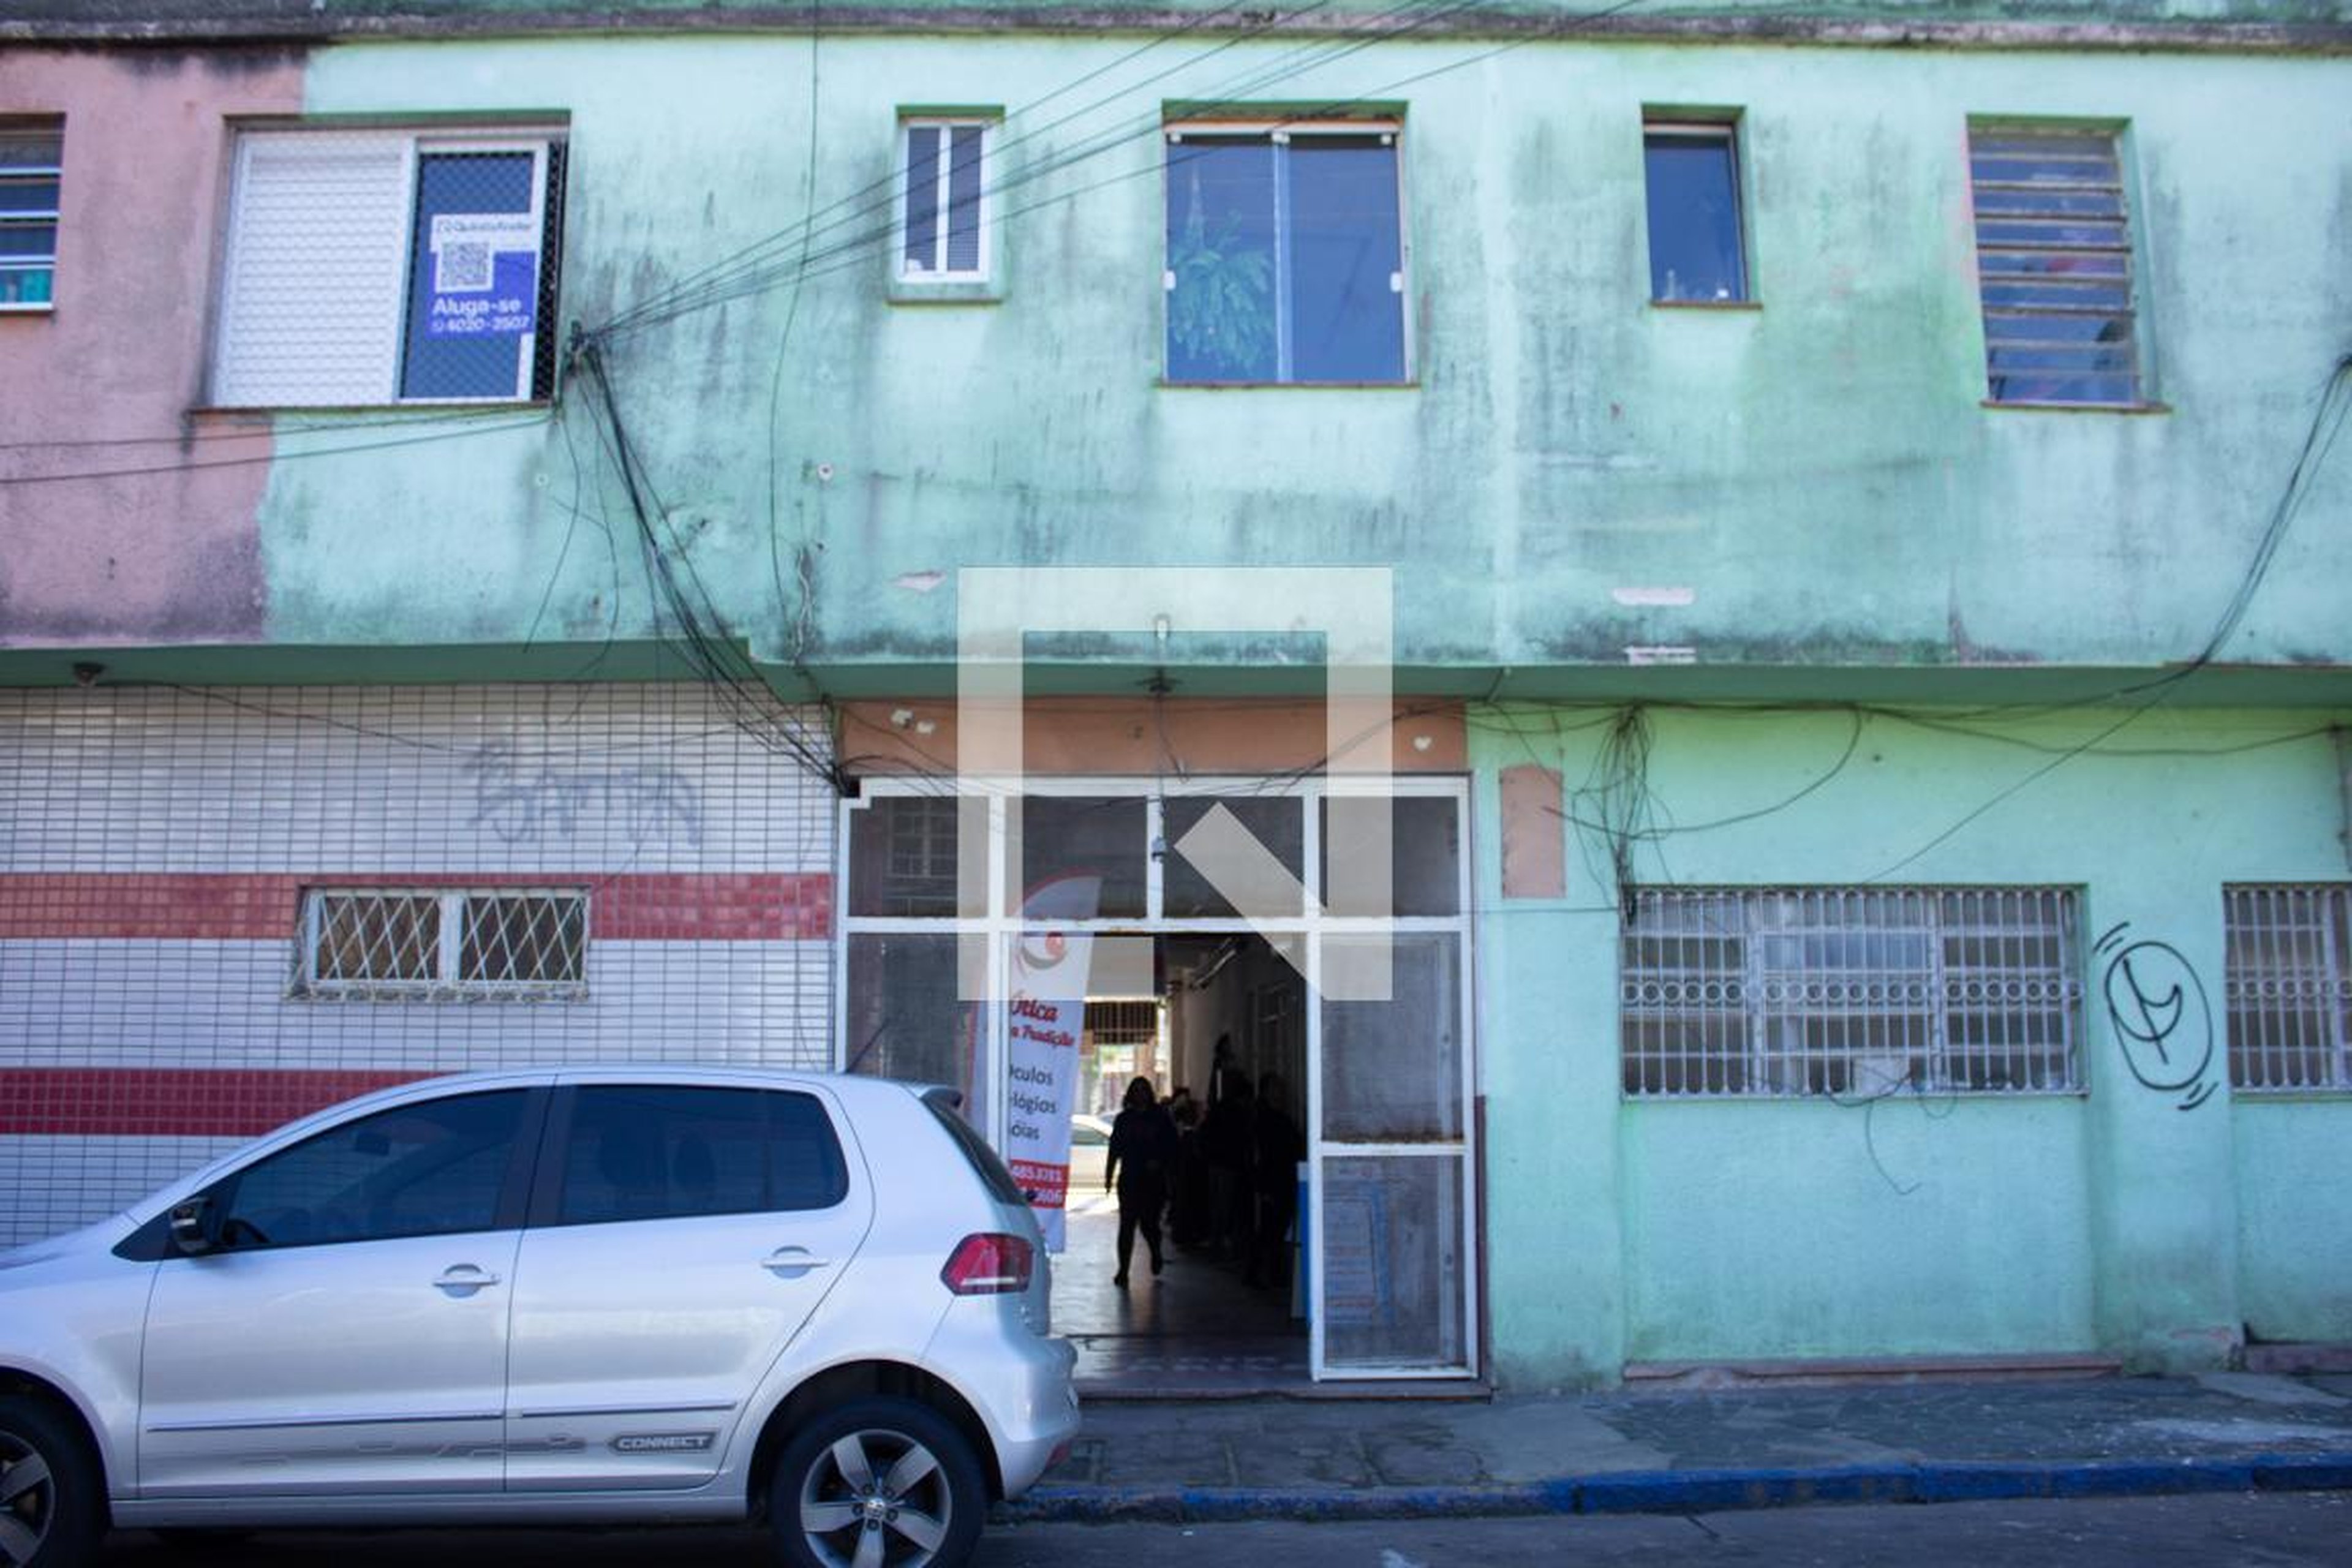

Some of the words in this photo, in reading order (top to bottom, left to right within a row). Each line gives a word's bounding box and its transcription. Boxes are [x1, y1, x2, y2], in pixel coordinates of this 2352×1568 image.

[432, 298, 521, 318] Aluga-se
[1013, 1091, 1056, 1115] lógios
[617, 1436, 706, 1450] CONNECT
